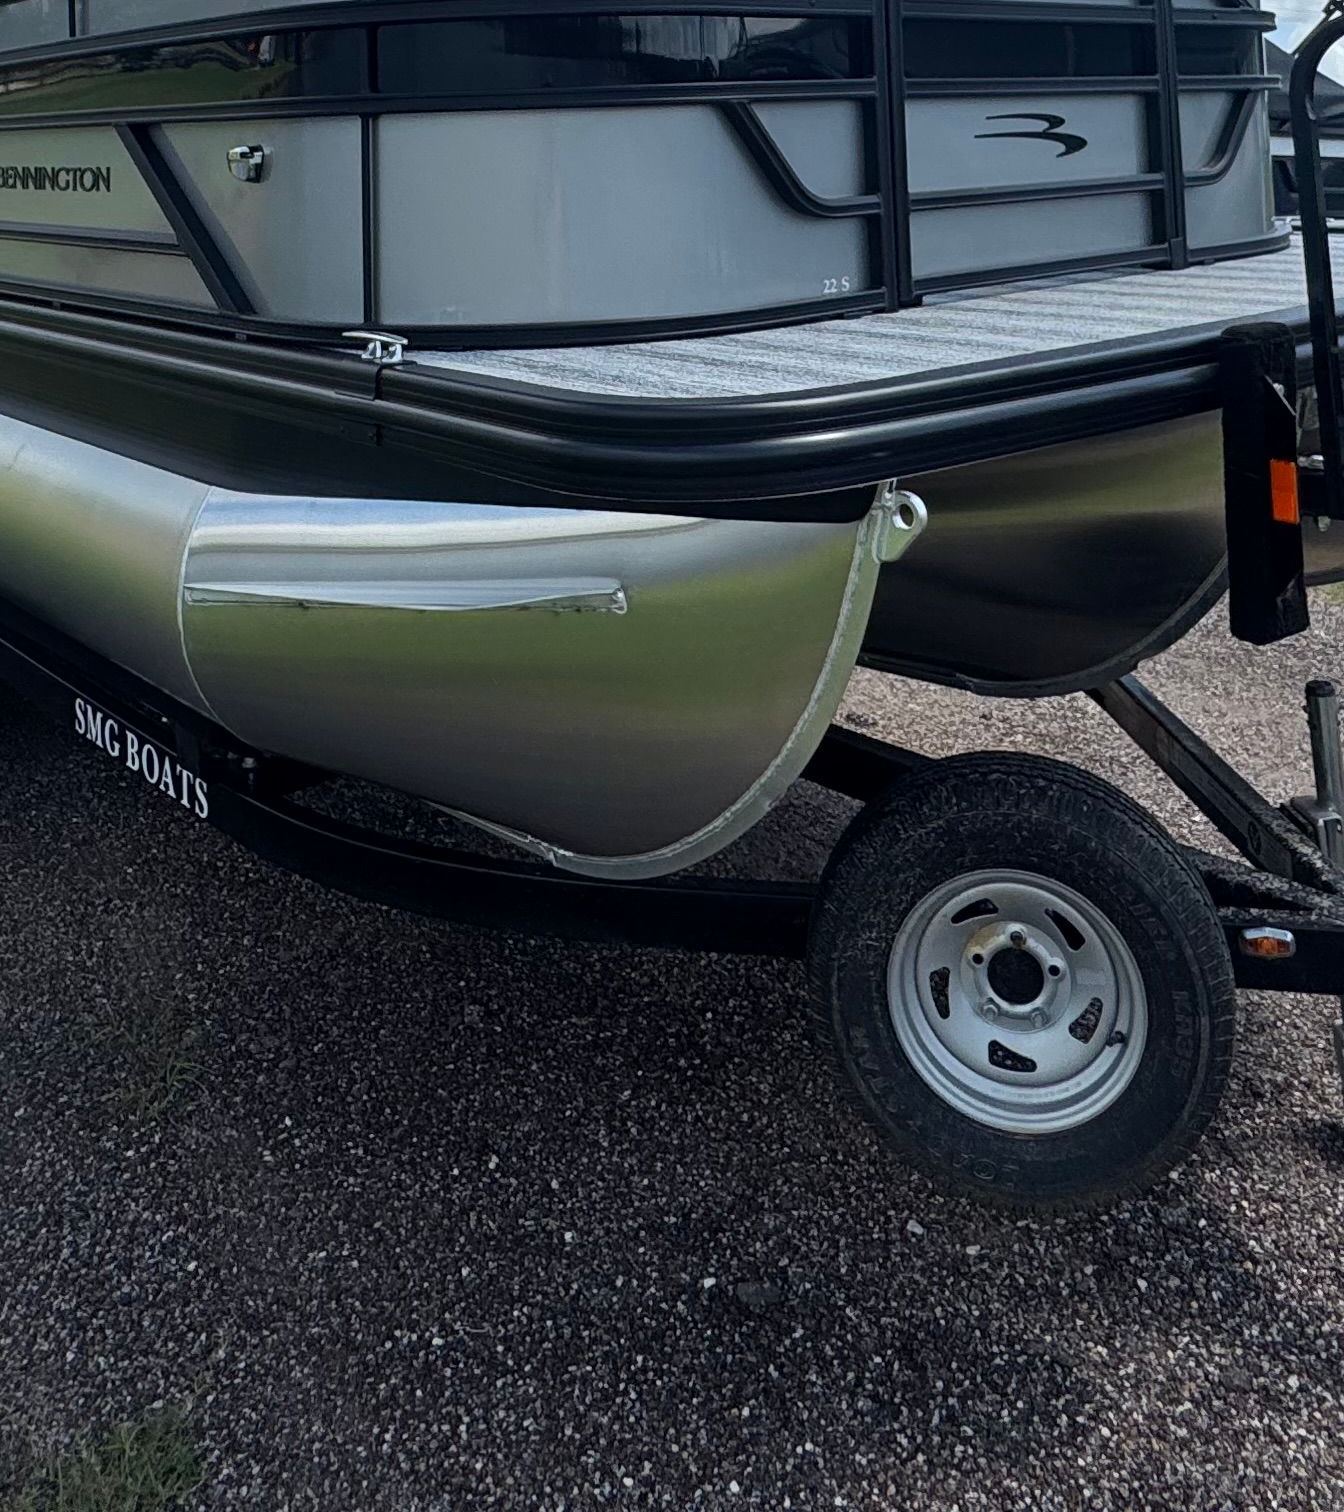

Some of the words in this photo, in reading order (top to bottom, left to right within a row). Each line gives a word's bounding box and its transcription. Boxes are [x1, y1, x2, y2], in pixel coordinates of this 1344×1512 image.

[823, 277, 838, 294] 22
[841, 275, 850, 292] S
[74, 697, 121, 757] SMG
[125, 730, 208, 819] BOATS
